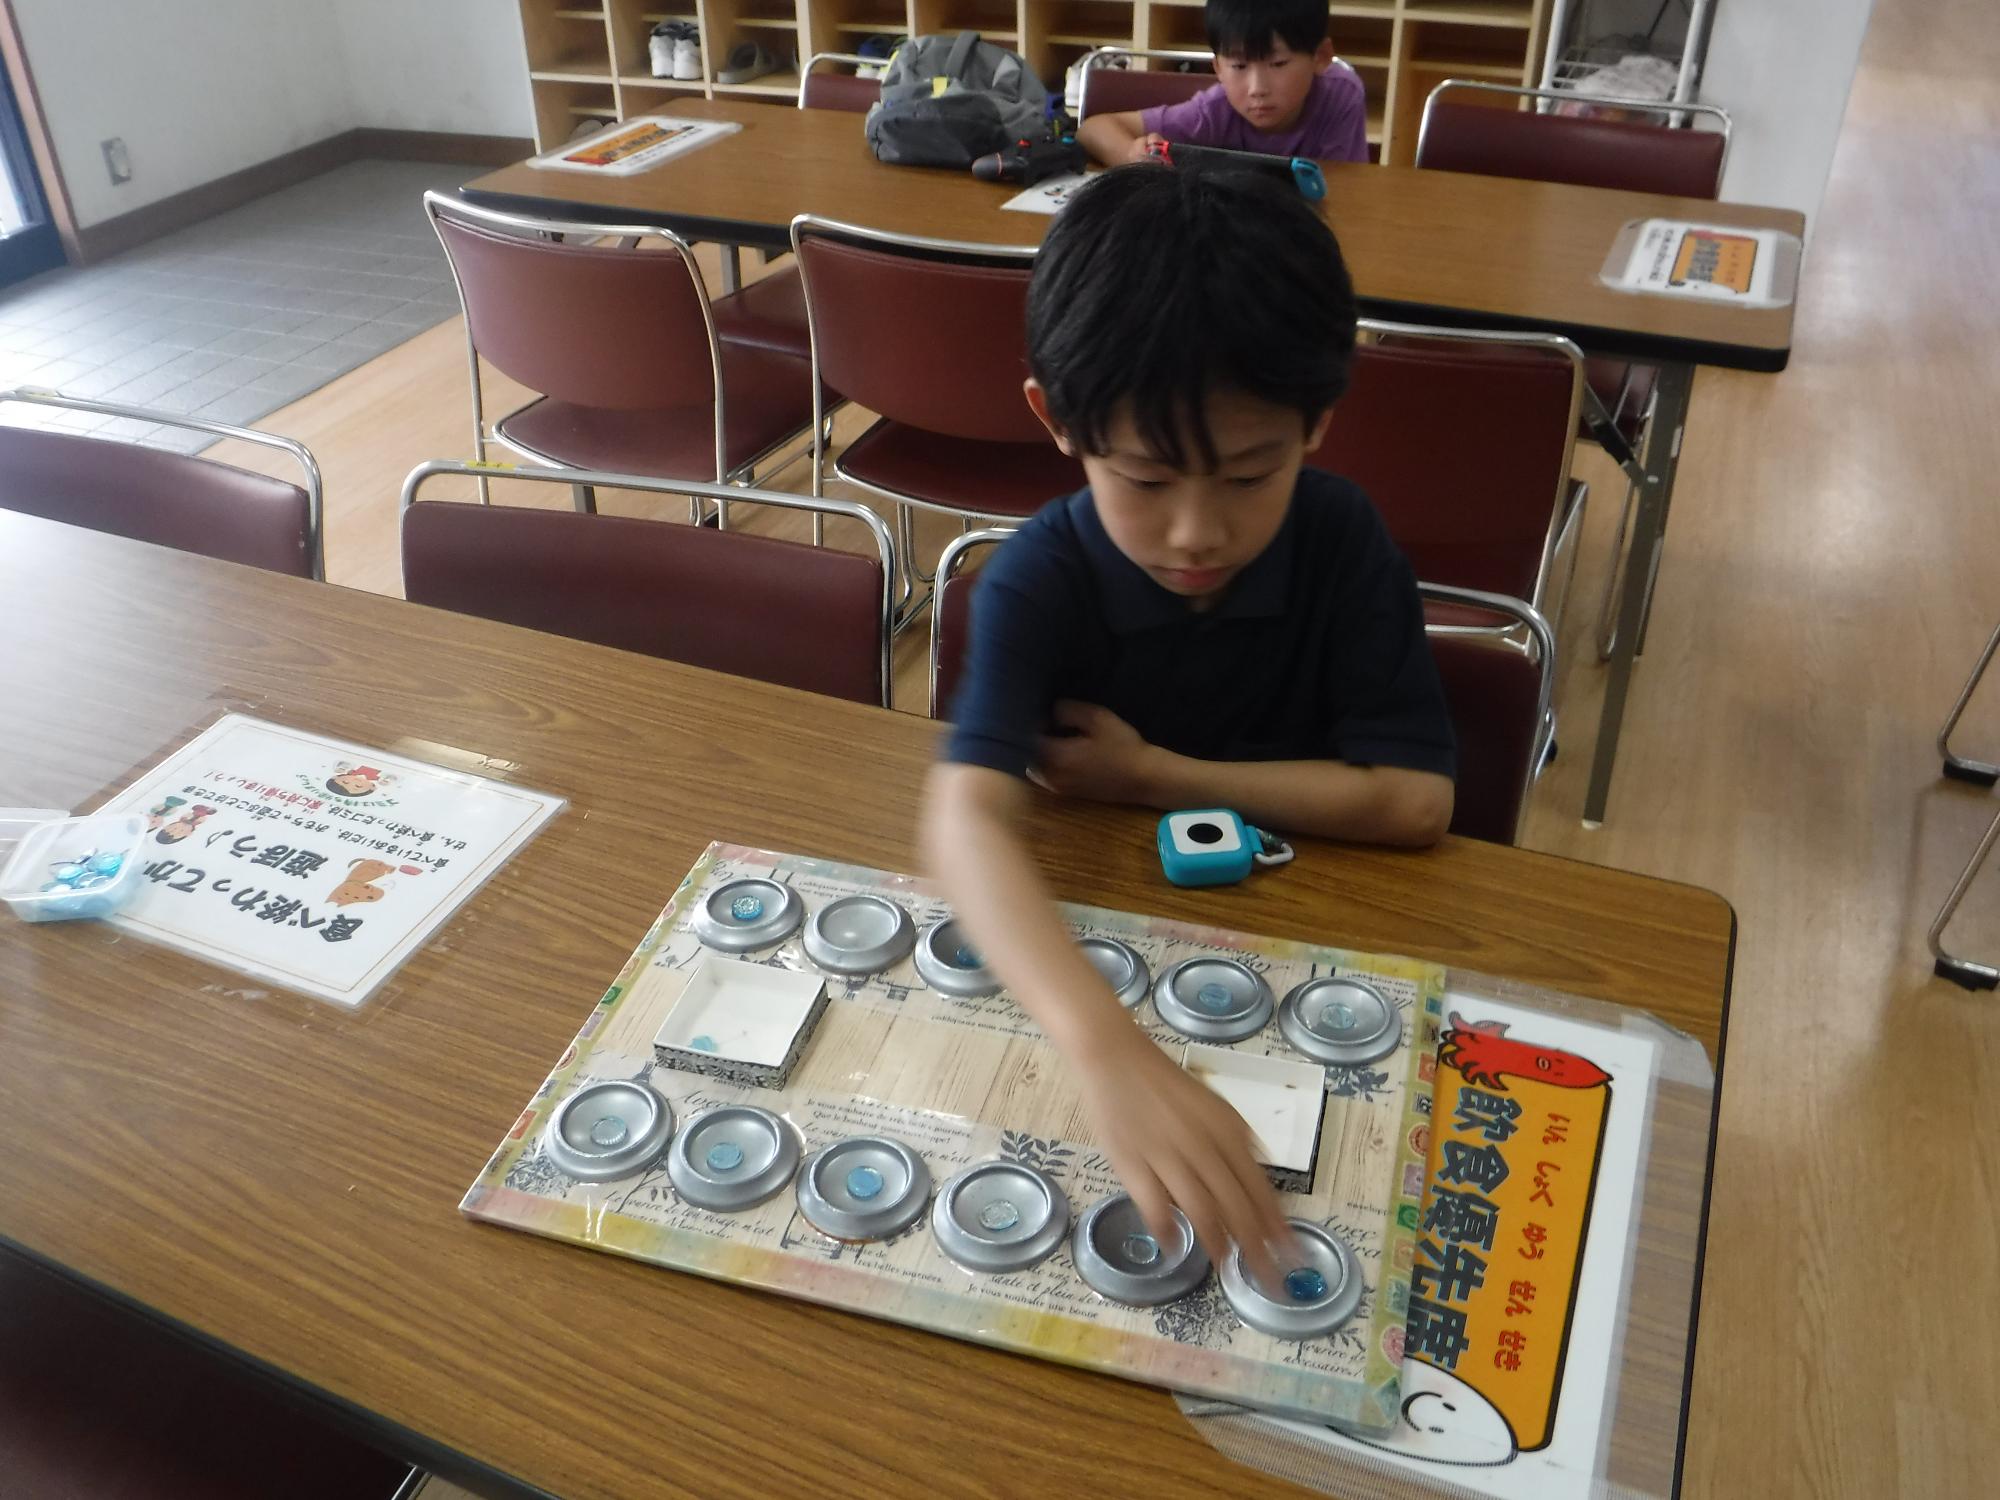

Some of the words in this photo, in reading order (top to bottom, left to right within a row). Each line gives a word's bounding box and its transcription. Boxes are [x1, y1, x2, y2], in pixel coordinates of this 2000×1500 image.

[138, 856, 364, 943] 食べ終わってか
[1541, 1111, 1571, 1146] いん
[1528, 1161, 1561, 1208] しょく
[1517, 1221, 1548, 1262] ゆう
[1504, 1279, 1537, 1318] せん
[1493, 1329, 1527, 1372] せき
